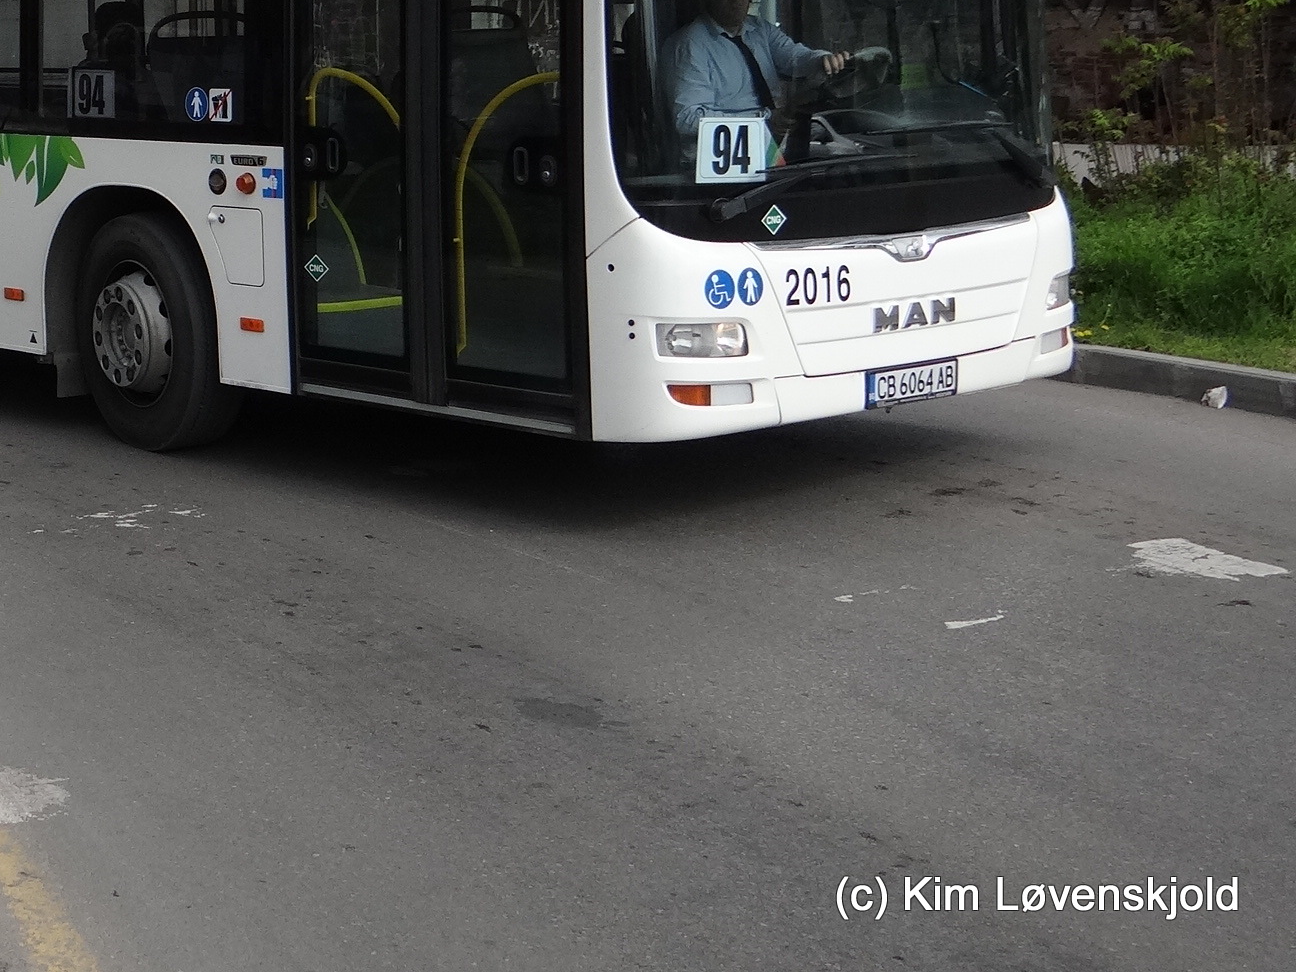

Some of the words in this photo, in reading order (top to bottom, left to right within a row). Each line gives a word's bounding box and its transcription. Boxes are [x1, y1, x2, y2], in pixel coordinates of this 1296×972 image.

[78, 74, 105, 115] 94
[233, 157, 254, 166] EURO
[258, 158, 264, 166] 6
[712, 124, 751, 175] 94
[766, 215, 782, 225] CNG
[309, 263, 324, 273] CNG
[786, 265, 851, 306] 2016
[873, 297, 956, 333] MAN
[877, 375, 896, 399] CB
[900, 369, 933, 395] 6064
[937, 365, 953, 390] AB
